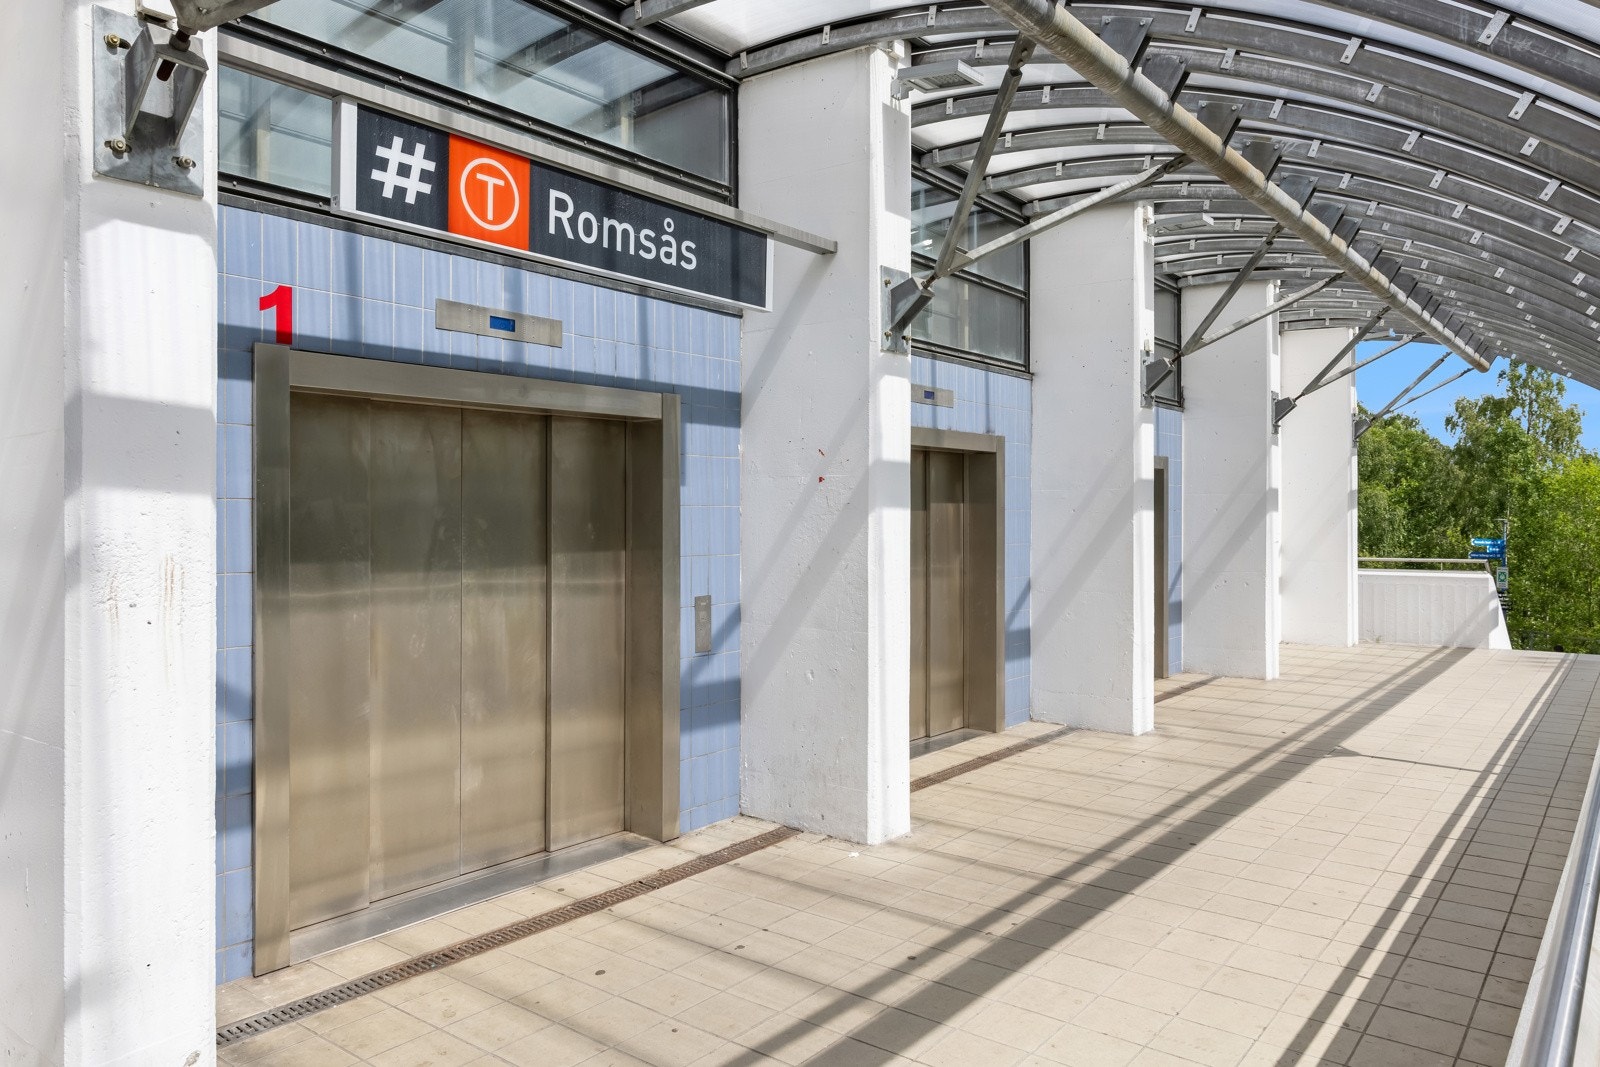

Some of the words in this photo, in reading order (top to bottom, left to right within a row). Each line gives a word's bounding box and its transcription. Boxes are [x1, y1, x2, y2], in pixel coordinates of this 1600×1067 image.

[476, 172, 505, 221] T
[548, 188, 697, 271] Romsås
[258, 284, 293, 345] 1
